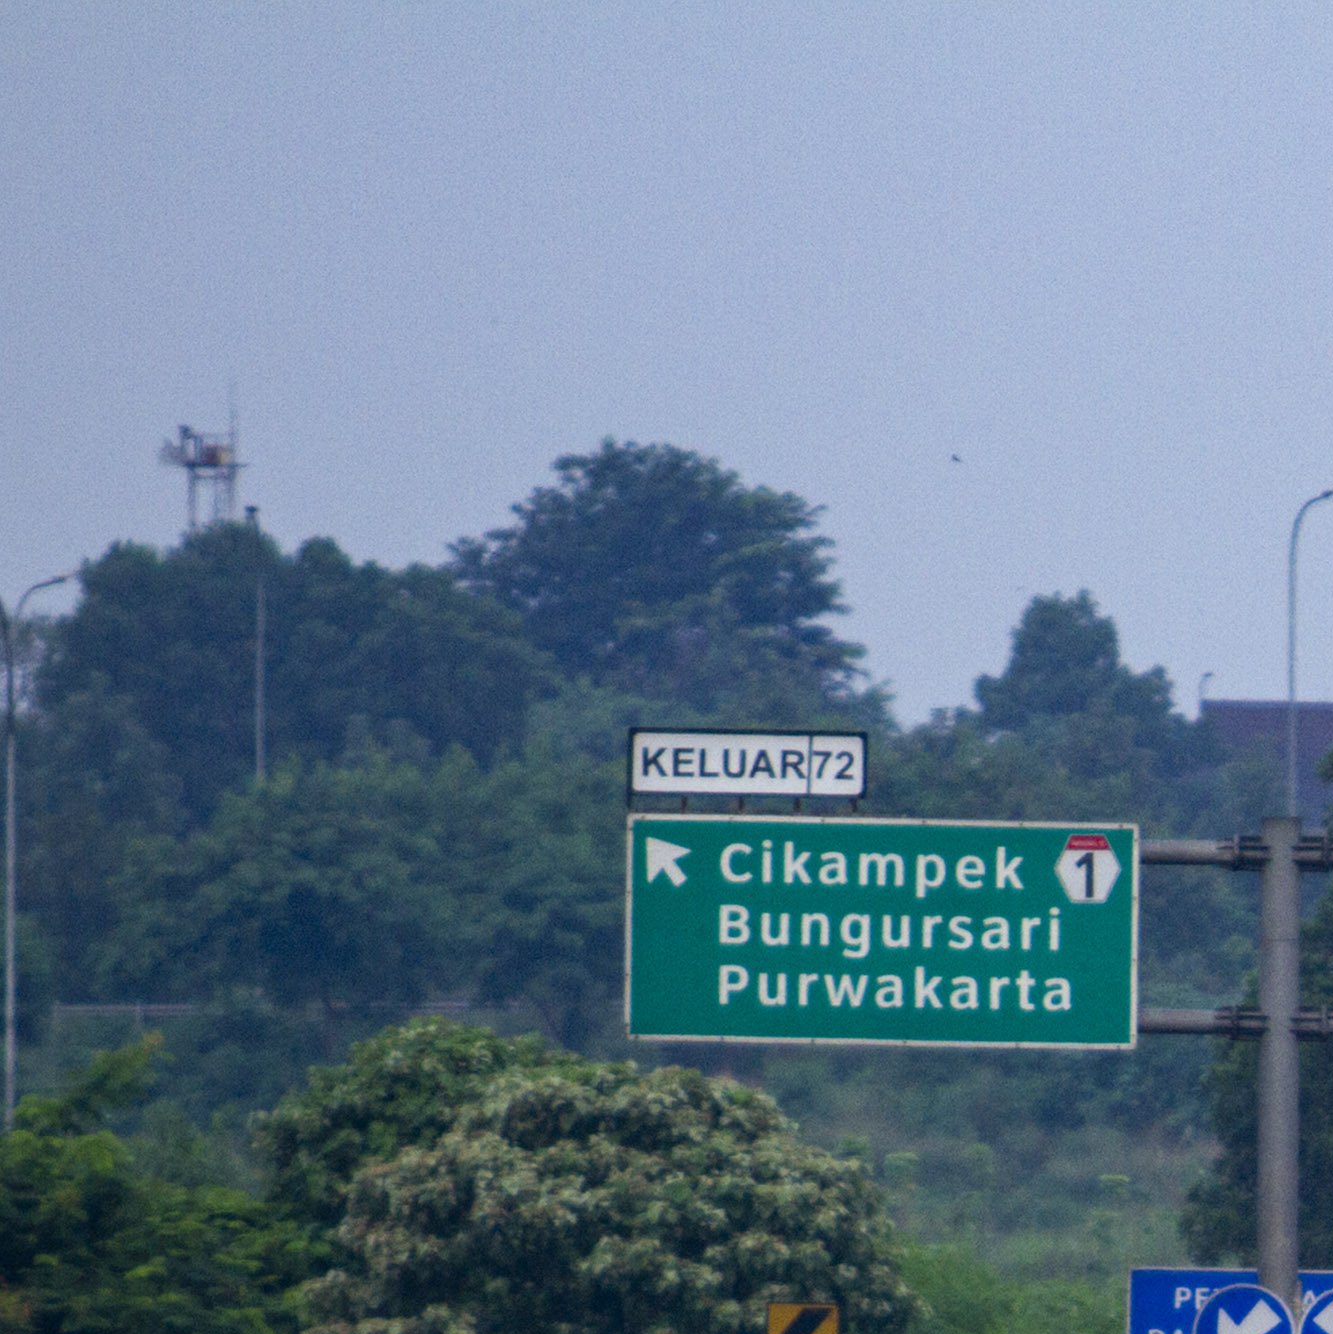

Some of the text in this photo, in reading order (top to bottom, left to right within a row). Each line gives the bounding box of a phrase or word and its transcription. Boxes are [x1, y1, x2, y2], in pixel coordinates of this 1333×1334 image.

[641, 747, 856, 781] KELUAR 72
[719, 840, 1025, 899] Cikampek
[1074, 851, 1095, 899] 1
[718, 904, 1063, 959] Bungursari
[718, 964, 1072, 1012] Purwakarta
